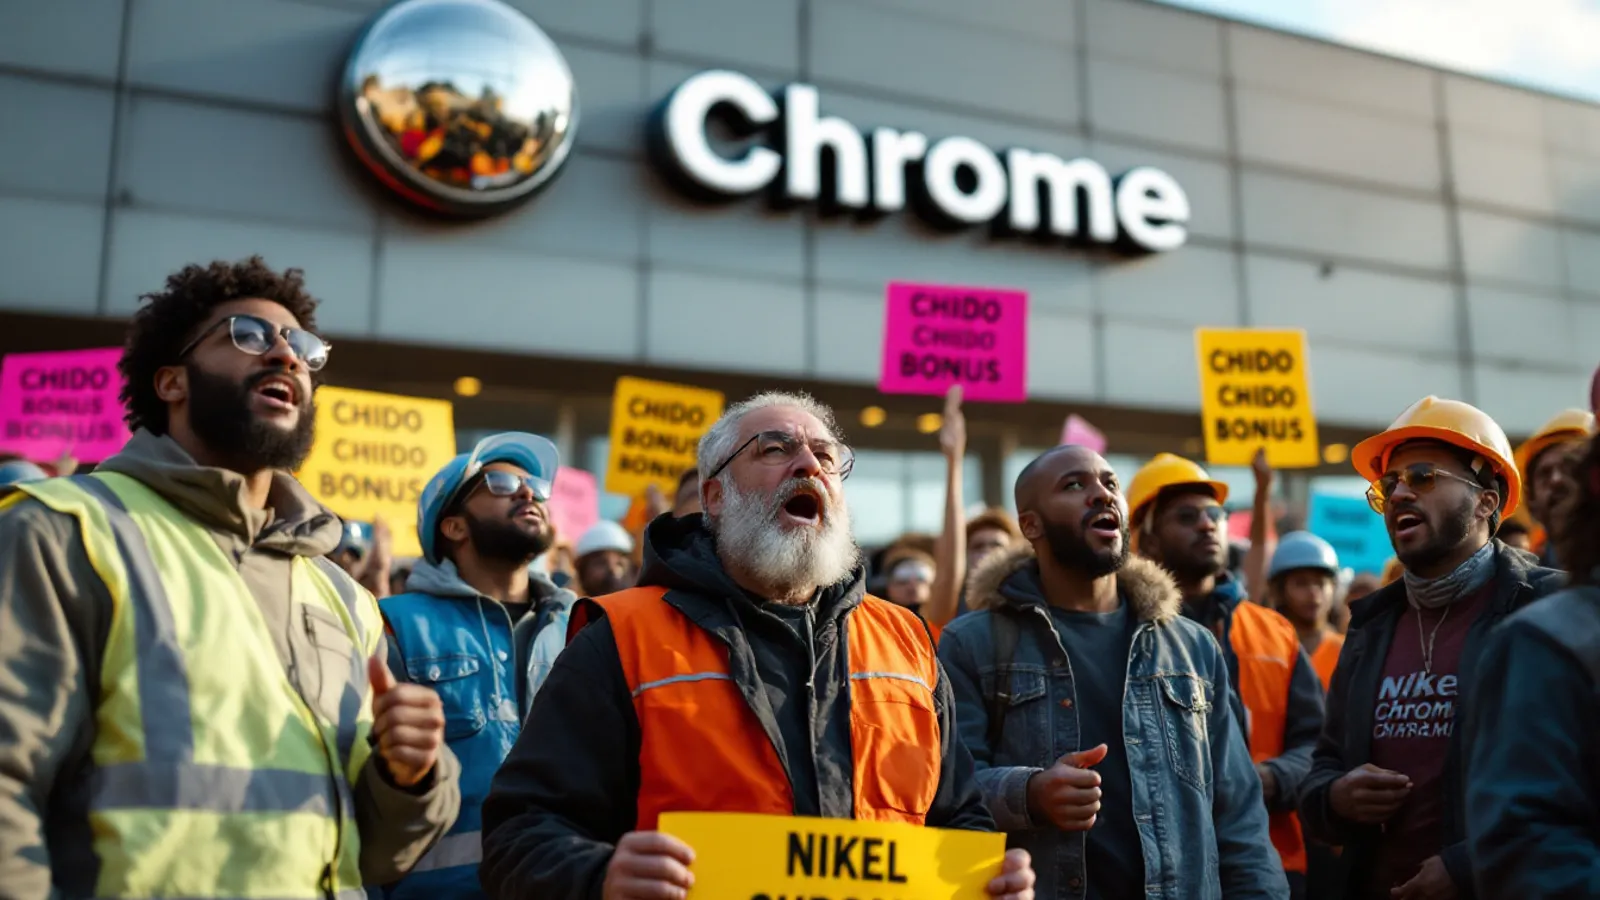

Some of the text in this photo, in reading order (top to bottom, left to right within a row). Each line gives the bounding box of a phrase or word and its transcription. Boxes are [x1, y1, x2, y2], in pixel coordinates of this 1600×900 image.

[667, 69, 1190, 252] Chrome
[909, 292, 1003, 324] CHIDO
[900, 352, 1003, 384] BONUS
[1209, 348, 1294, 374] CHIDO
[19, 366, 110, 391] CHIDO
[1217, 384, 1297, 411] CHIDO
[331, 400, 424, 433] CHIDO
[1215, 416, 1305, 442] BONUS
[786, 831, 908, 884] NIKEL
